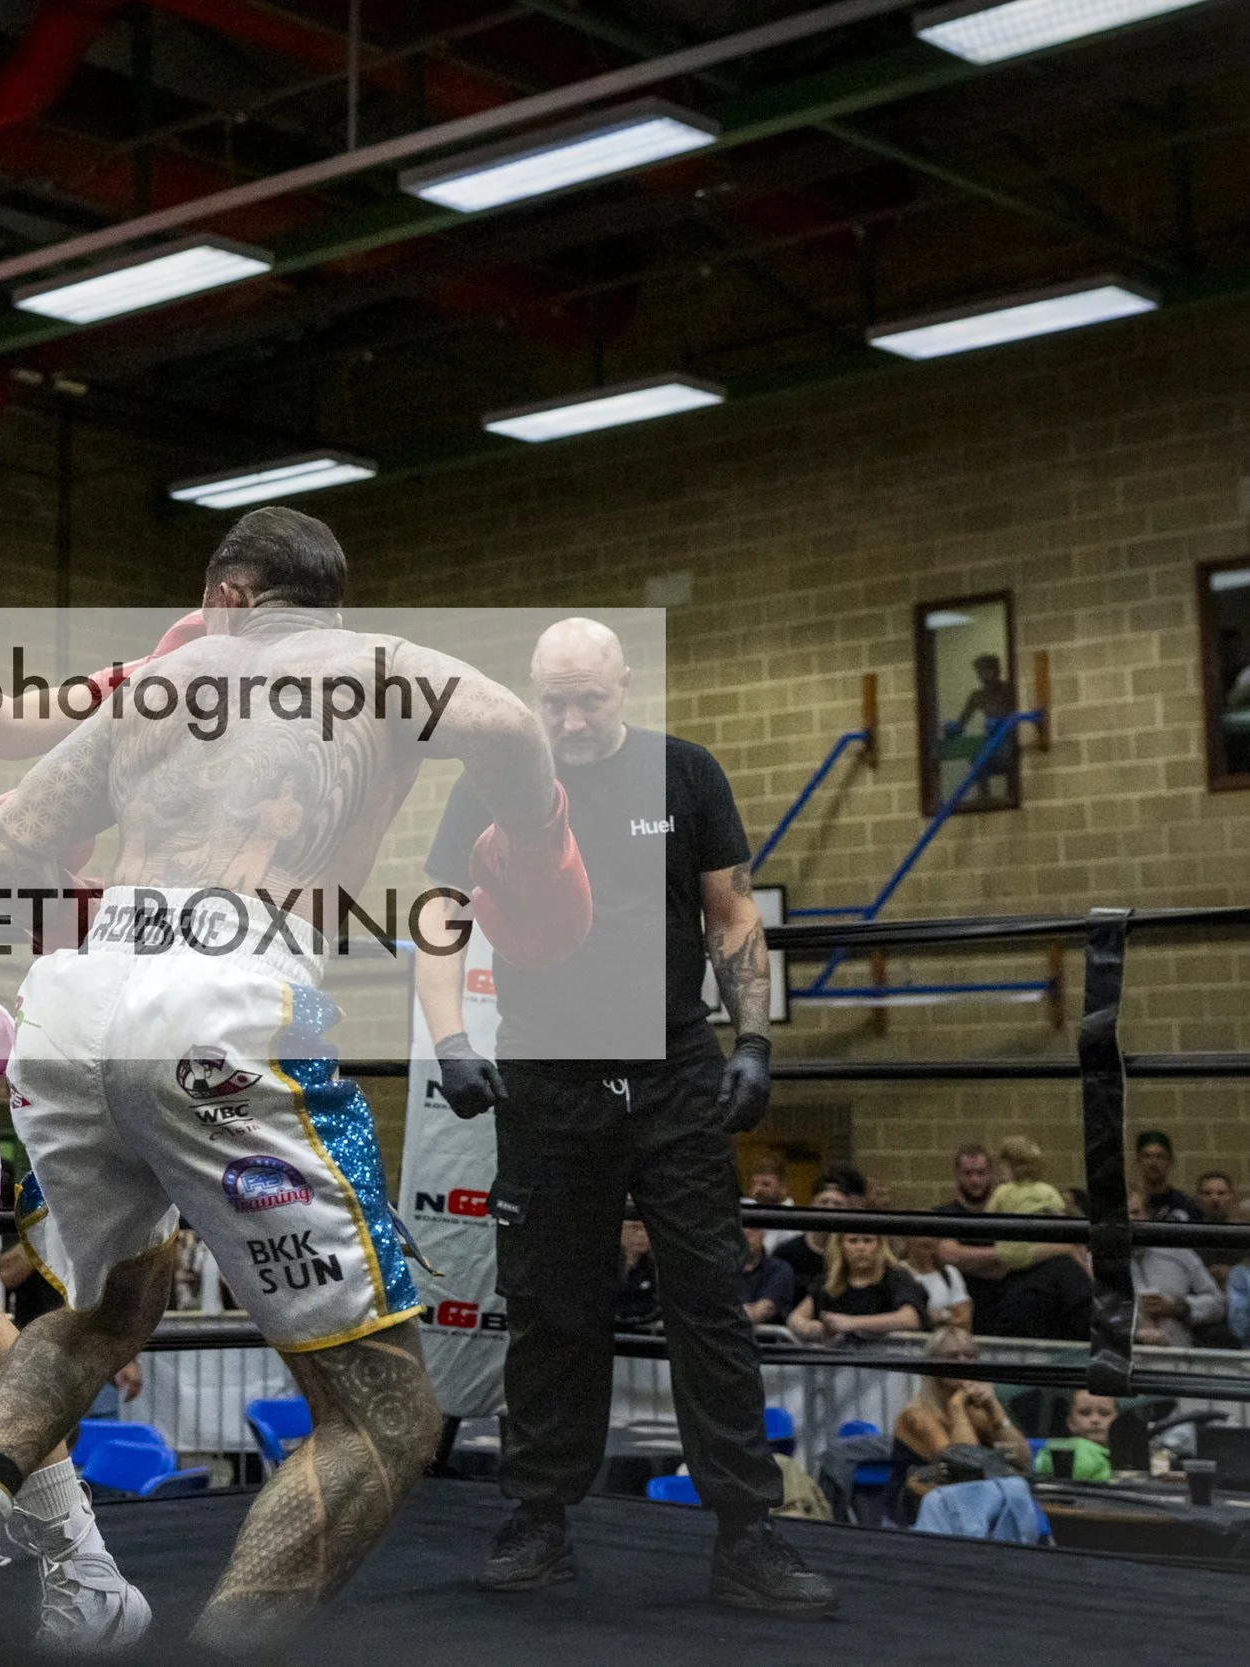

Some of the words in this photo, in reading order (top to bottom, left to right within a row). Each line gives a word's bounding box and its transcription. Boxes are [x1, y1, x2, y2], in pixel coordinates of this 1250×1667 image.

[630, 814, 675, 836] Huel
[194, 1103, 250, 1123] WBC
[246, 1230, 319, 1265] BKK
[259, 1253, 344, 1294] SUN
